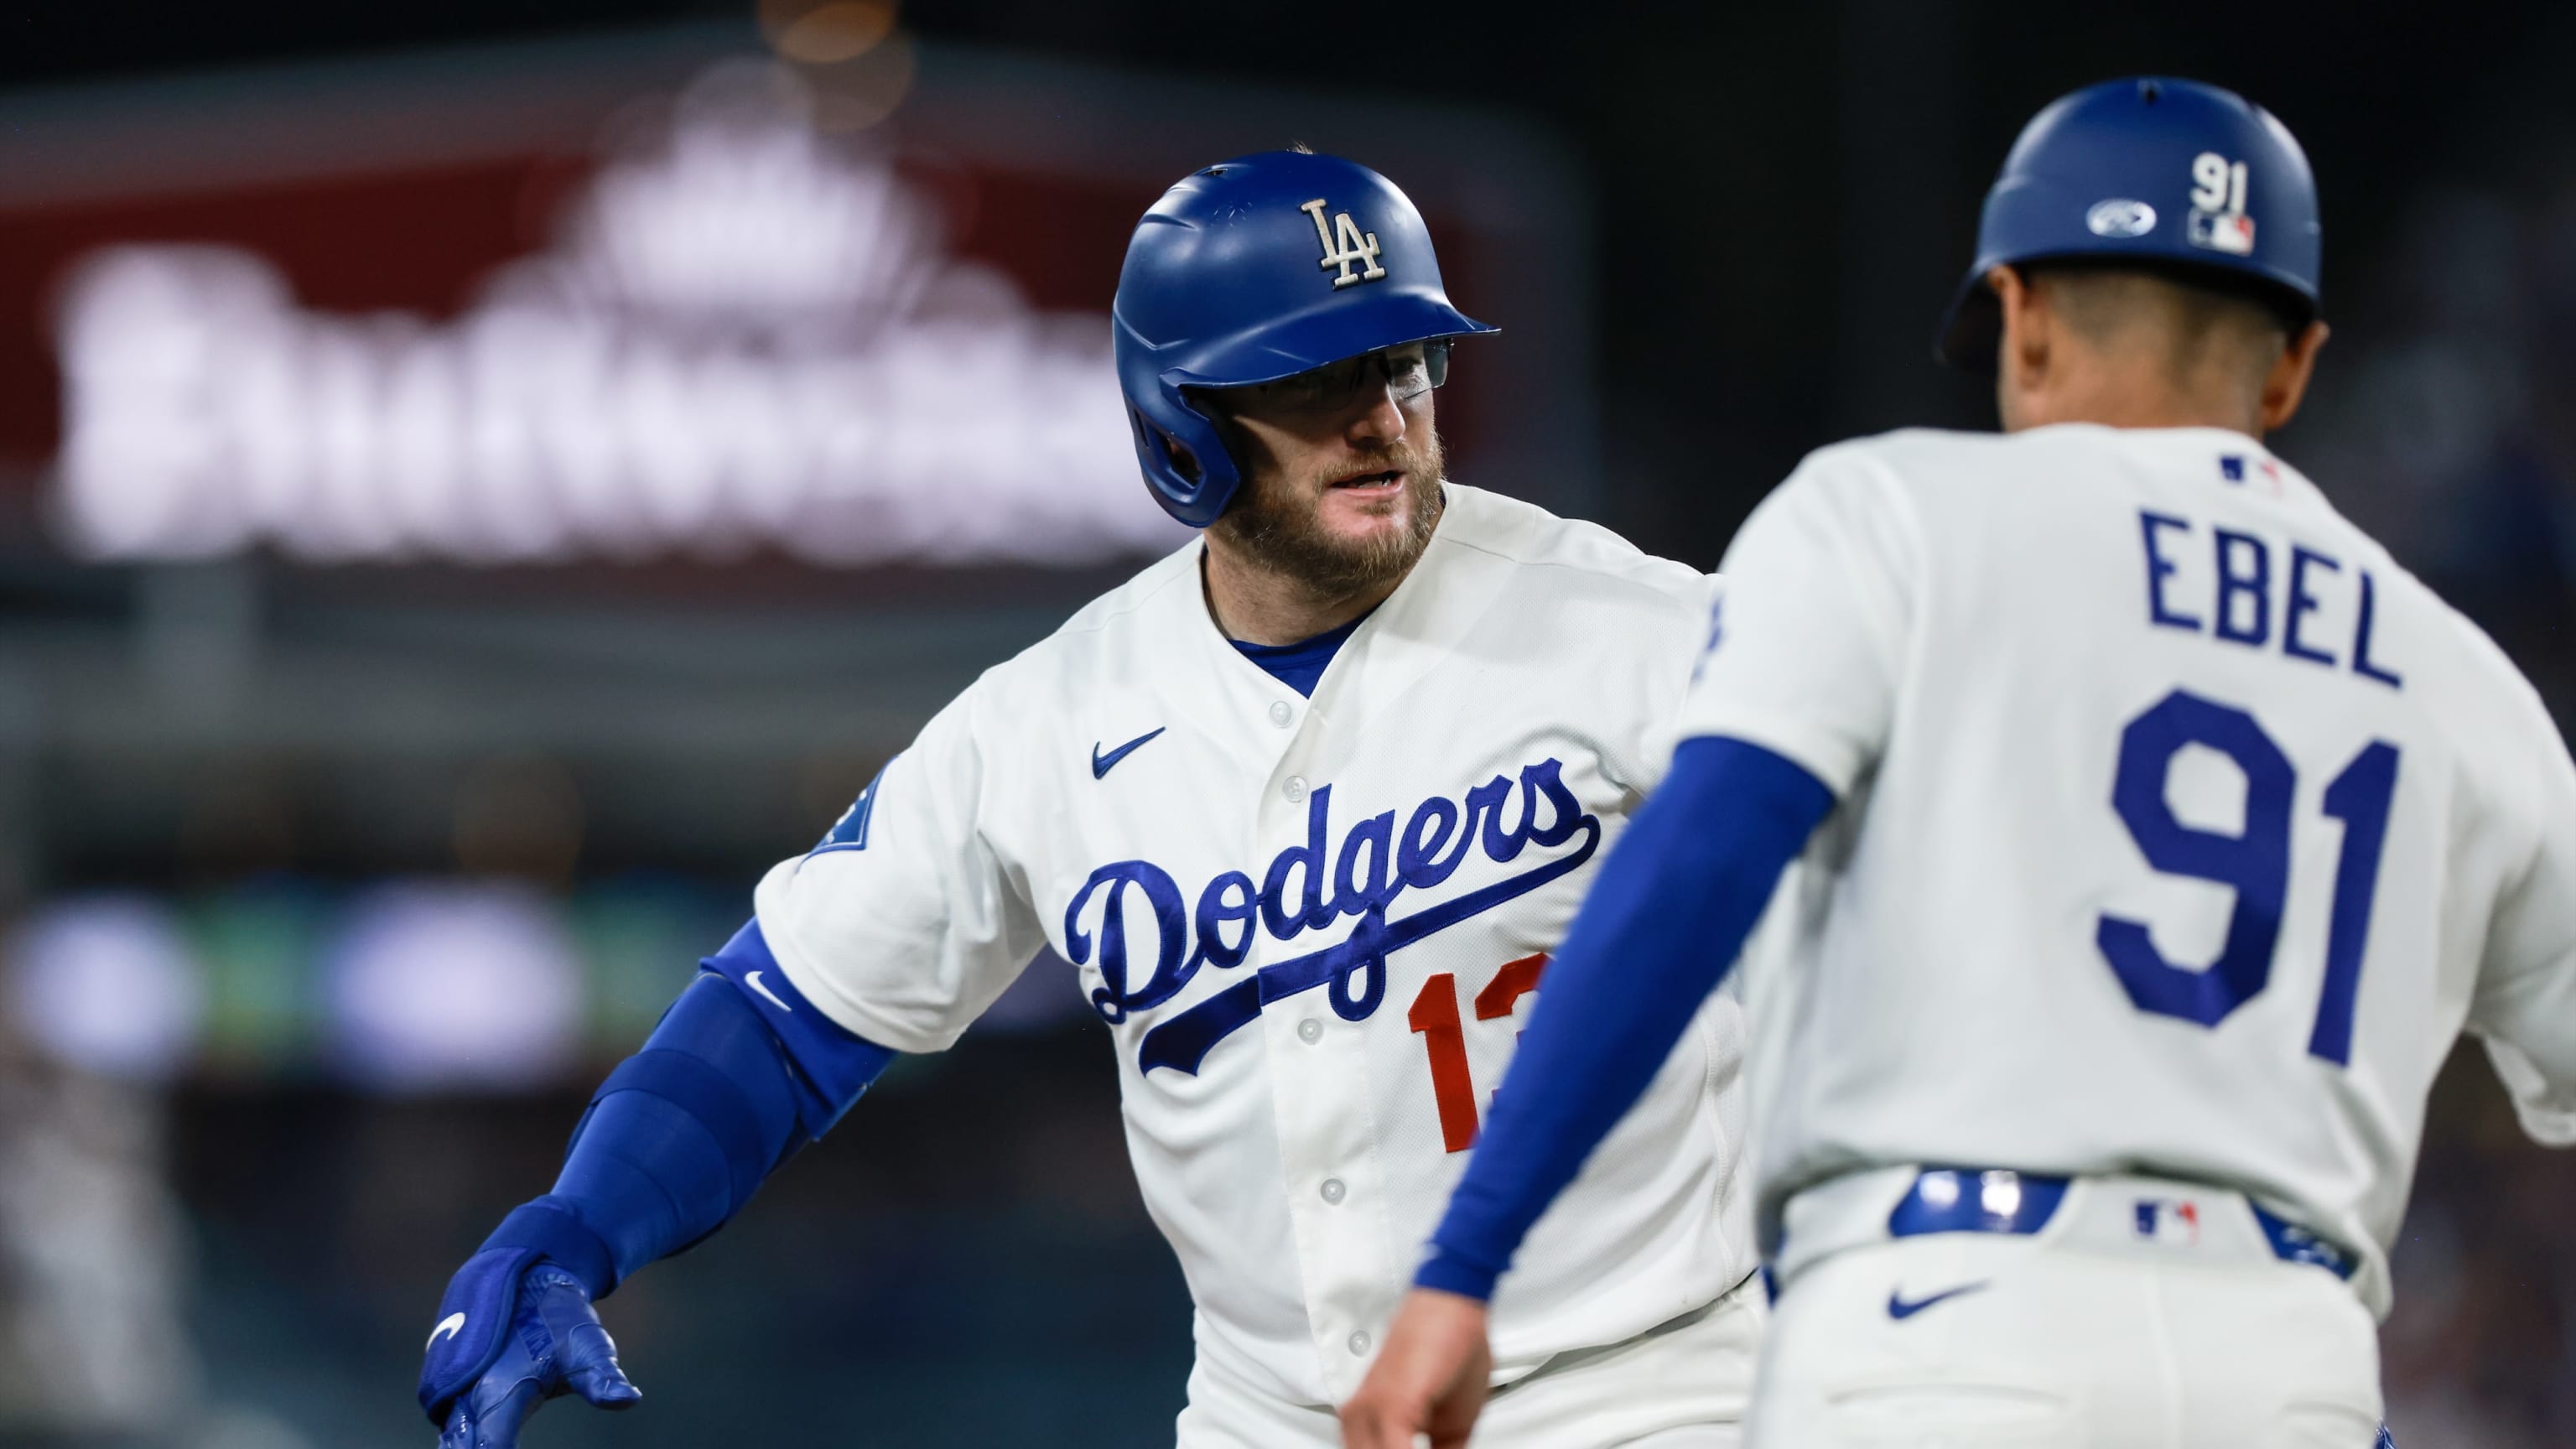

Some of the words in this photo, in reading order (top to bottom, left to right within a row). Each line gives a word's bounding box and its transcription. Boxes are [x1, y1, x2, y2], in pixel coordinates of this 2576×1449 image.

[1301, 198, 1386, 287] LA
[2189, 151, 2248, 216] 91
[2139, 508, 2403, 690] EBEL
[1064, 757, 1601, 1025] Dodgers
[2096, 687, 2401, 1068] 91
